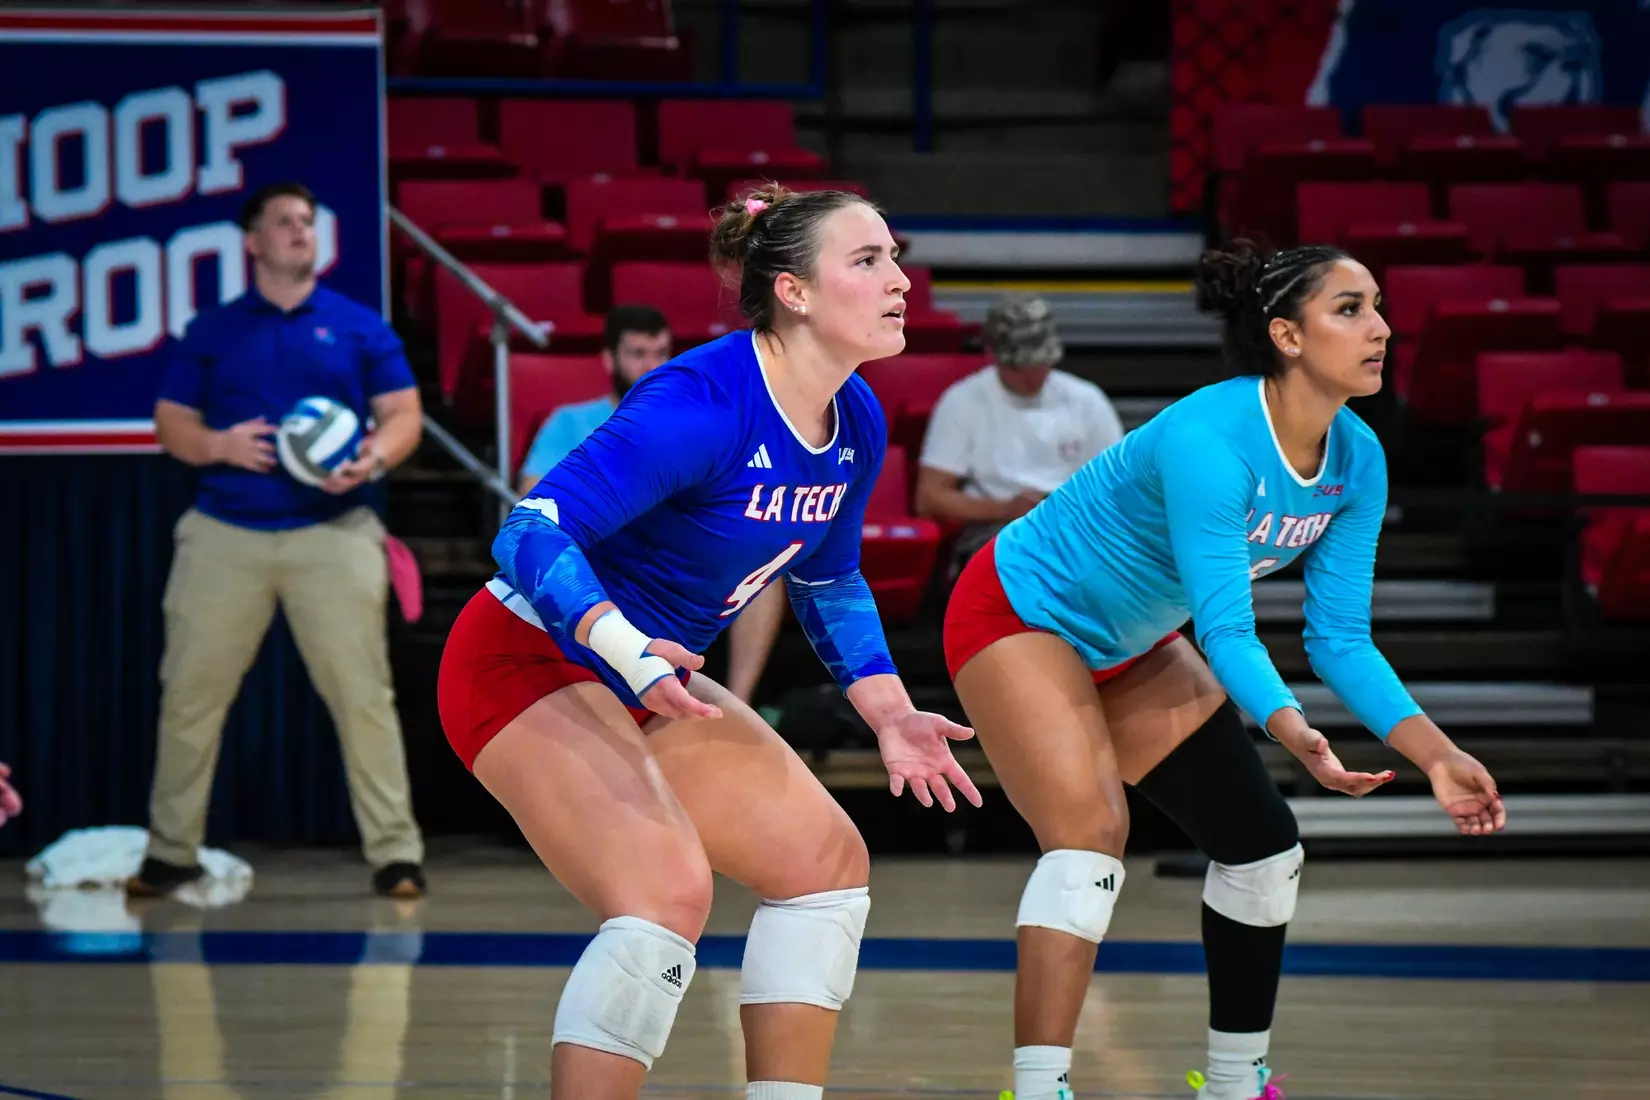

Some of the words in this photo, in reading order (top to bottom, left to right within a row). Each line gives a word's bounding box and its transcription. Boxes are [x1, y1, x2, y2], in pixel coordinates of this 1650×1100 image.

[0, 203, 338, 378] ROO
[744, 483, 787, 522] LA
[791, 482, 848, 522] TECH
[1246, 507, 1274, 545] A
[718, 541, 805, 618] 4
